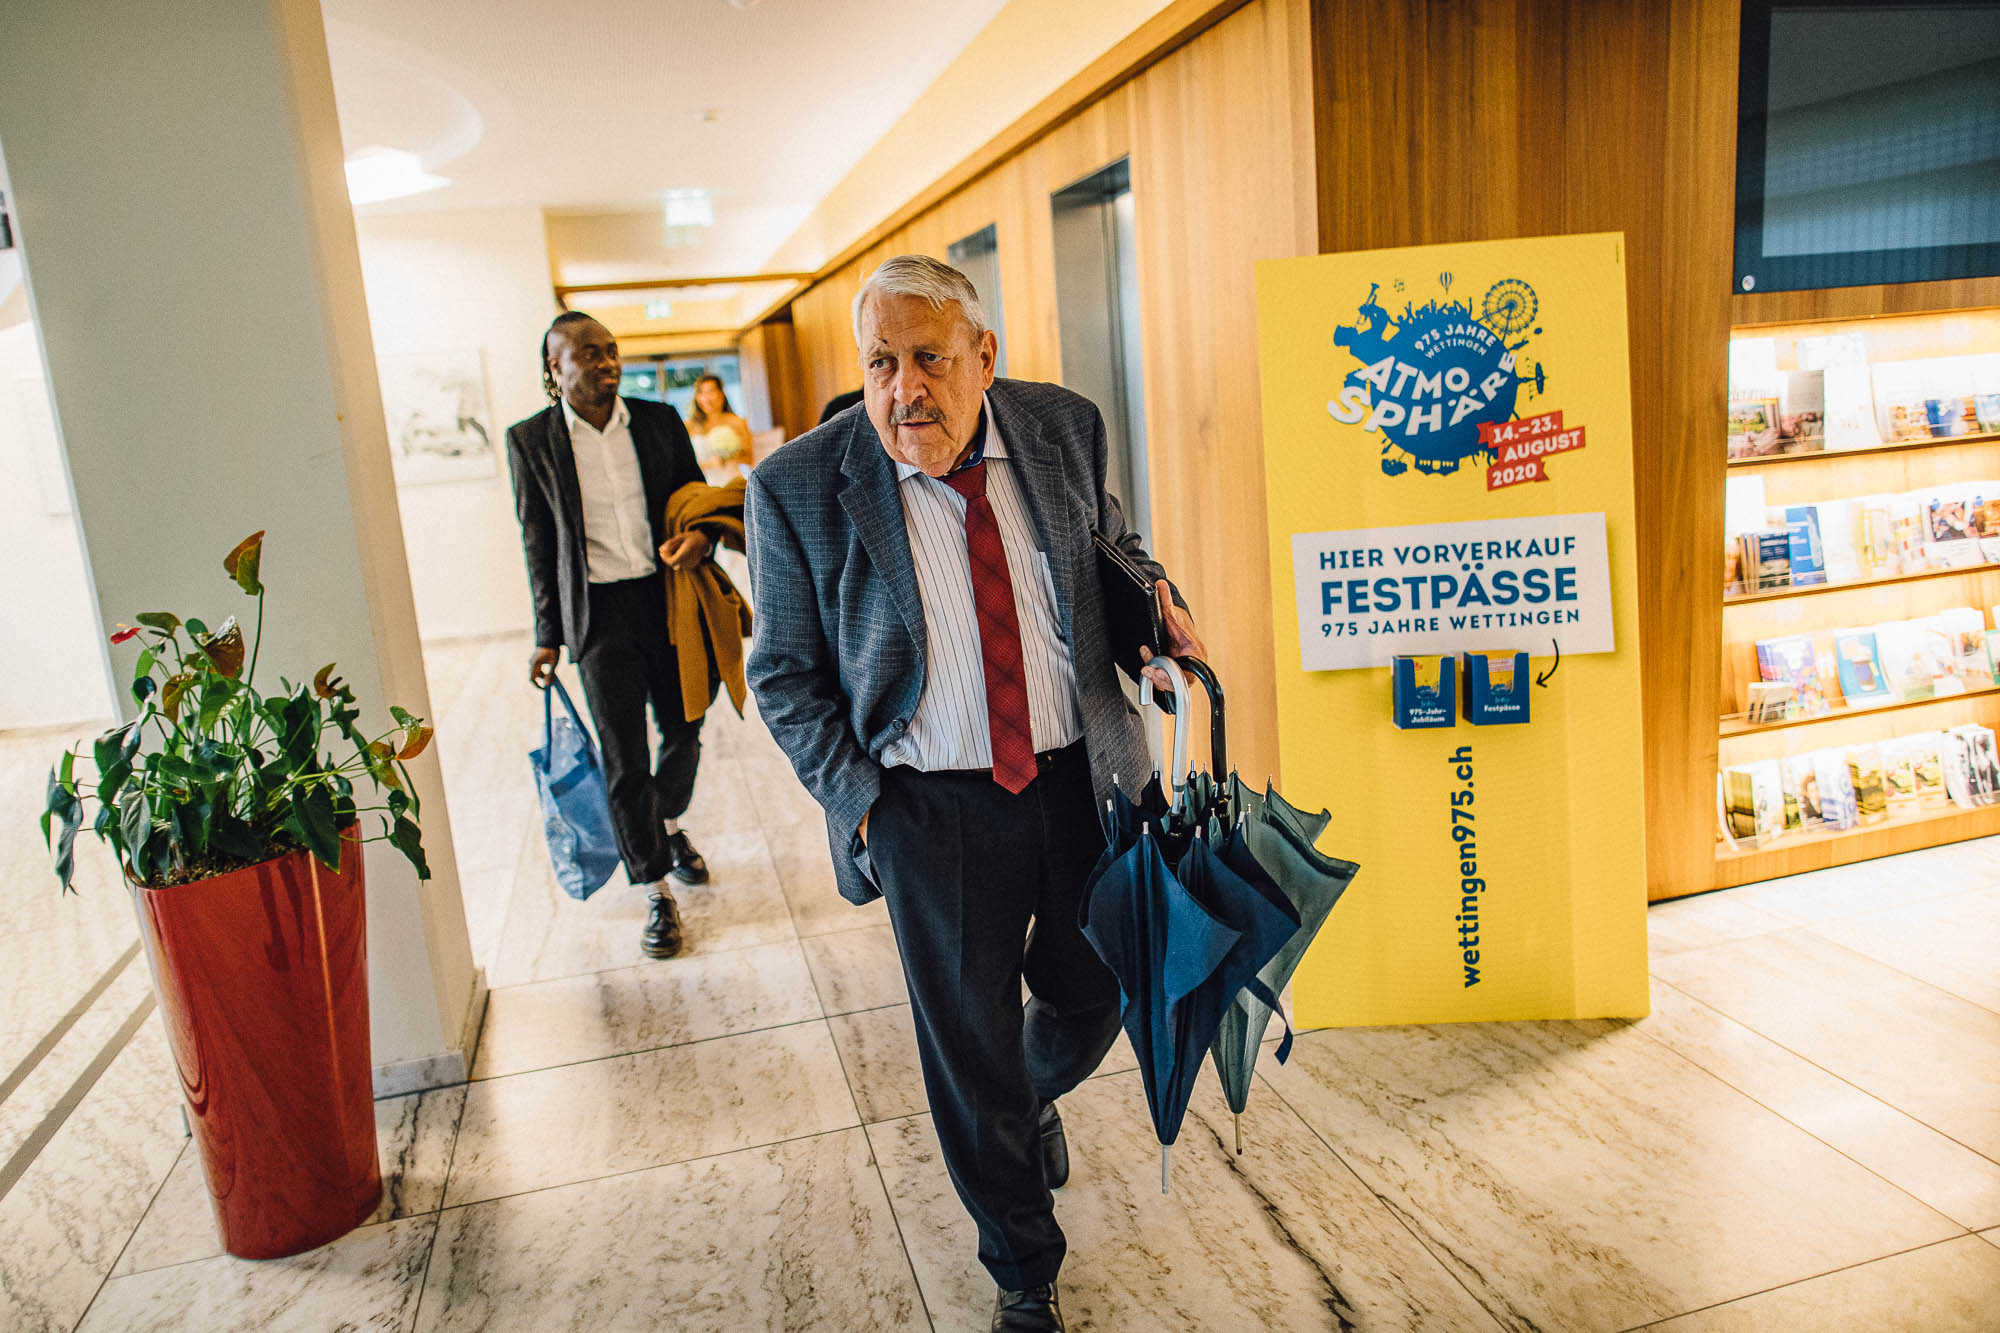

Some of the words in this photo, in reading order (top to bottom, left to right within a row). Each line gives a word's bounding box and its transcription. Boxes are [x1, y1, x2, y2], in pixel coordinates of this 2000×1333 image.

[1414, 327, 1441, 351] 975
[1444, 323, 1497, 347] JAHRE
[1424, 337, 1488, 360] WETTINGEN
[1328, 351, 1517, 436] SPHÄRE
[1354, 355, 1470, 401] ATMO
[1503, 430, 1582, 463] AUGUST
[1492, 462, 1538, 488] 2020
[1320, 548, 1384, 571] HIER
[1394, 536, 1576, 565] VORVERKAUF
[1321, 562, 1578, 616] FESTPÄSSE
[1321, 620, 1359, 638] 975
[1368, 616, 1440, 635] JAHRE
[1449, 609, 1580, 631] WETTINGEN
[1411, 715, 1446, 724] Jubiläum
[1483, 704, 1521, 713] Festpässe
[1448, 746, 1486, 988] wettingen975.ch
